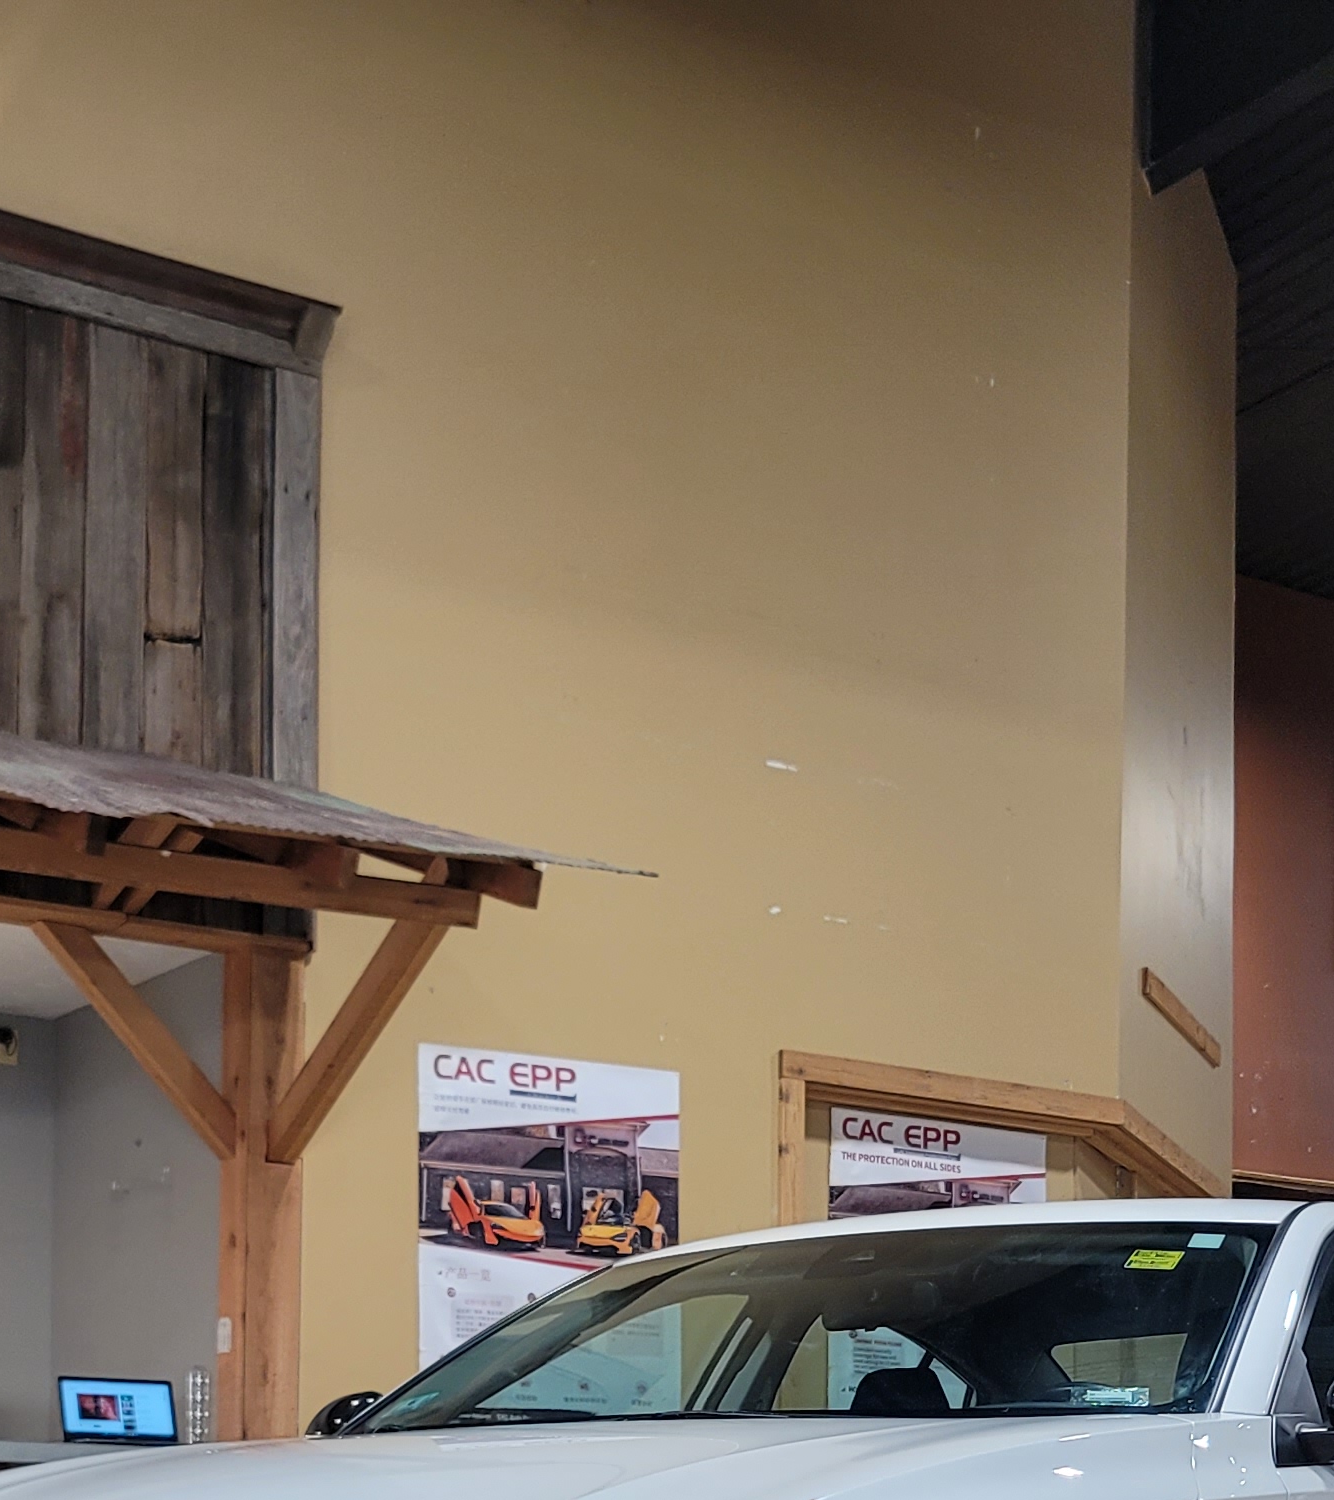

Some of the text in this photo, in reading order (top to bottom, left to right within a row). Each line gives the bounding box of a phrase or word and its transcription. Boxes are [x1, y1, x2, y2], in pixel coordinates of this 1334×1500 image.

[433, 1054, 576, 1092] CAC EPP
[842, 1117, 961, 1152] CAC EPP
[841, 1151, 961, 1174] THE PROTECTION ON ALL SIDES
